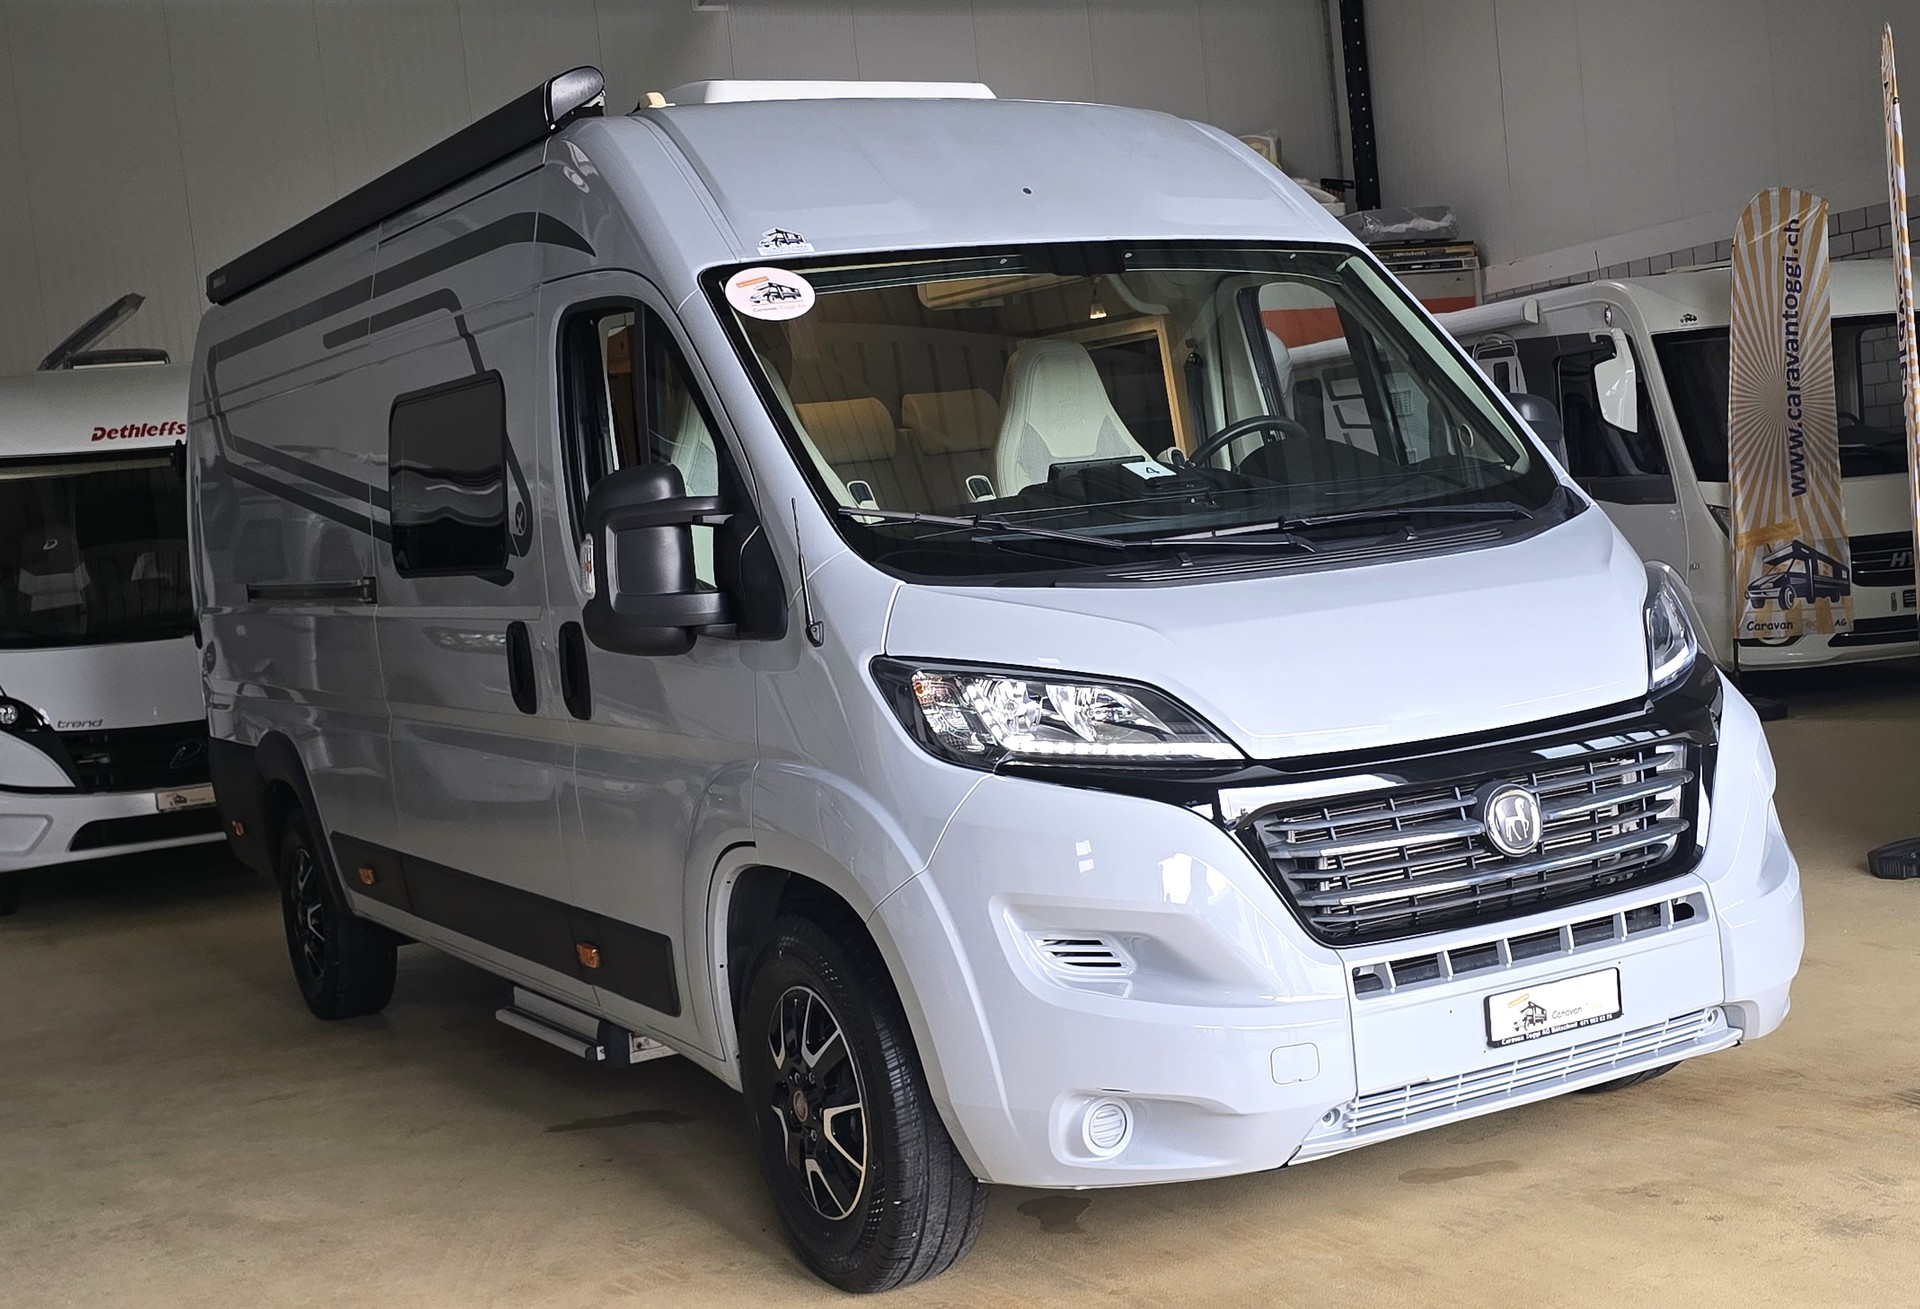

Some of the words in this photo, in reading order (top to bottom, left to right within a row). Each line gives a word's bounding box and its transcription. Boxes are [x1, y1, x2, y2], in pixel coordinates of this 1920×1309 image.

[1782, 218, 1807, 498] www.caravantoggi.ch
[91, 421, 187, 441] Dethleffs
[1746, 620, 1793, 631] Caravan
[57, 719, 103, 729] trend
[1552, 1006, 1582, 1020] Caravan
